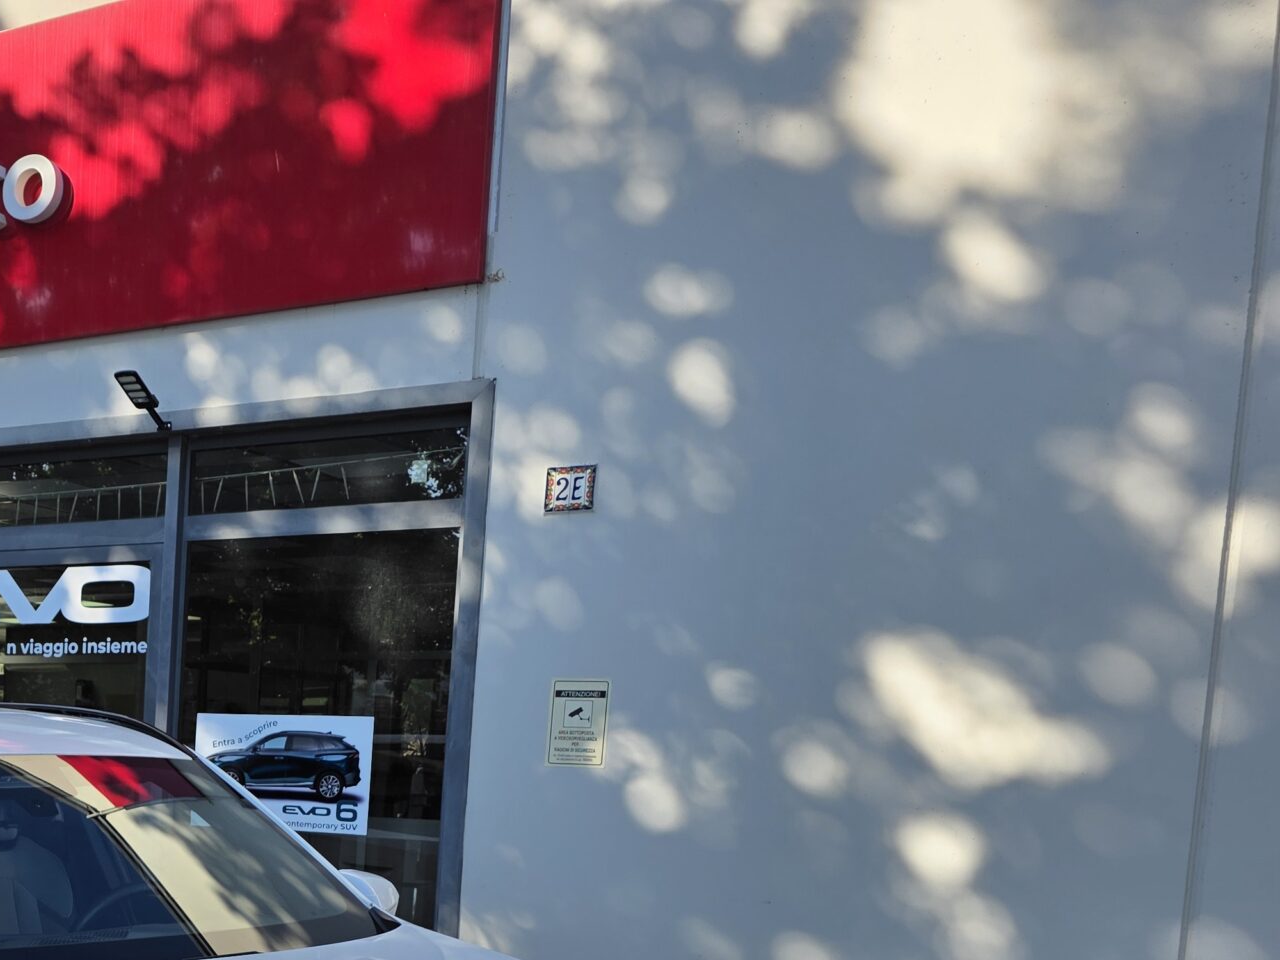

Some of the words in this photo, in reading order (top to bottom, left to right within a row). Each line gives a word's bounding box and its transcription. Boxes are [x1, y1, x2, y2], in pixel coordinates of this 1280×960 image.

[556, 476, 585, 501] 2E
[20, 638, 78, 658] viaggio
[82, 637, 148, 654] insieme
[212, 738, 235, 748] Entra
[244, 720, 278, 741] scoprire
[282, 804, 331, 816] EVO
[336, 800, 358, 823] 6
[284, 820, 338, 831] ontemporary
[340, 823, 358, 831] SUV
